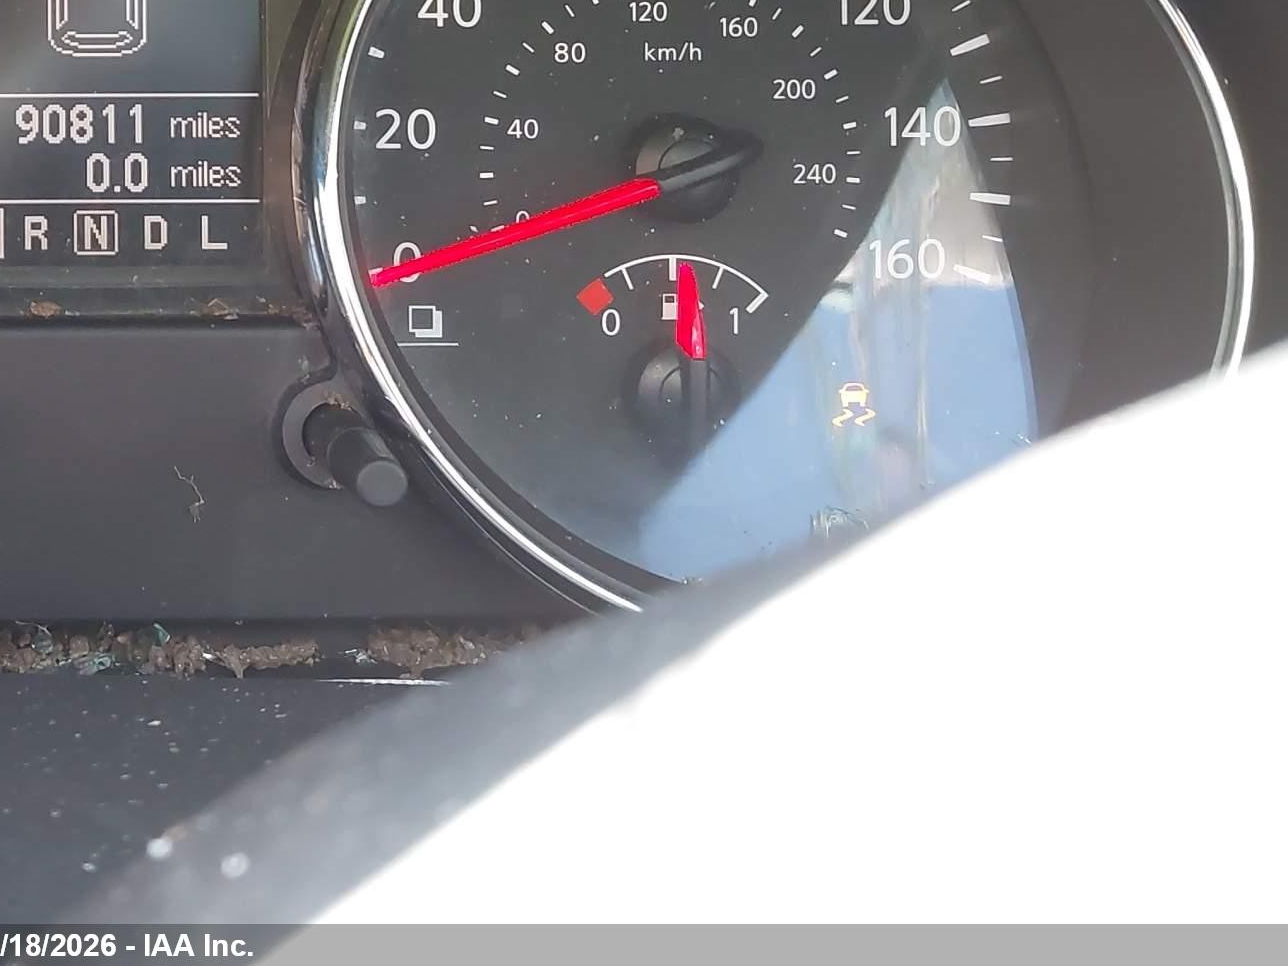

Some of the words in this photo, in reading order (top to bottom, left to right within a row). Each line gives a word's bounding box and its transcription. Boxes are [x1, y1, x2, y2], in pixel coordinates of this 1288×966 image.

[629, 1, 668, 22] 120
[719, 17, 758, 37] 160
[554, 42, 586, 63] 80
[644, 41, 702, 61] km/h
[773, 79, 816, 100] 200
[15, 103, 143, 145] 90811
[170, 111, 241, 138] miles
[375, 108, 436, 150] 20
[506, 118, 539, 139] 40
[884, 107, 961, 150] 140
[86, 152, 148, 193] 0.0
[170, 160, 241, 188] miles
[793, 163, 836, 184] 240
[24, 215, 48, 251] R
[84, 216, 109, 251] N
[144, 215, 168, 250] D
[201, 215, 228, 250] L
[868, 238, 948, 281] 160
[600, 309, 622, 337] 0
[729, 307, 739, 336] 1
